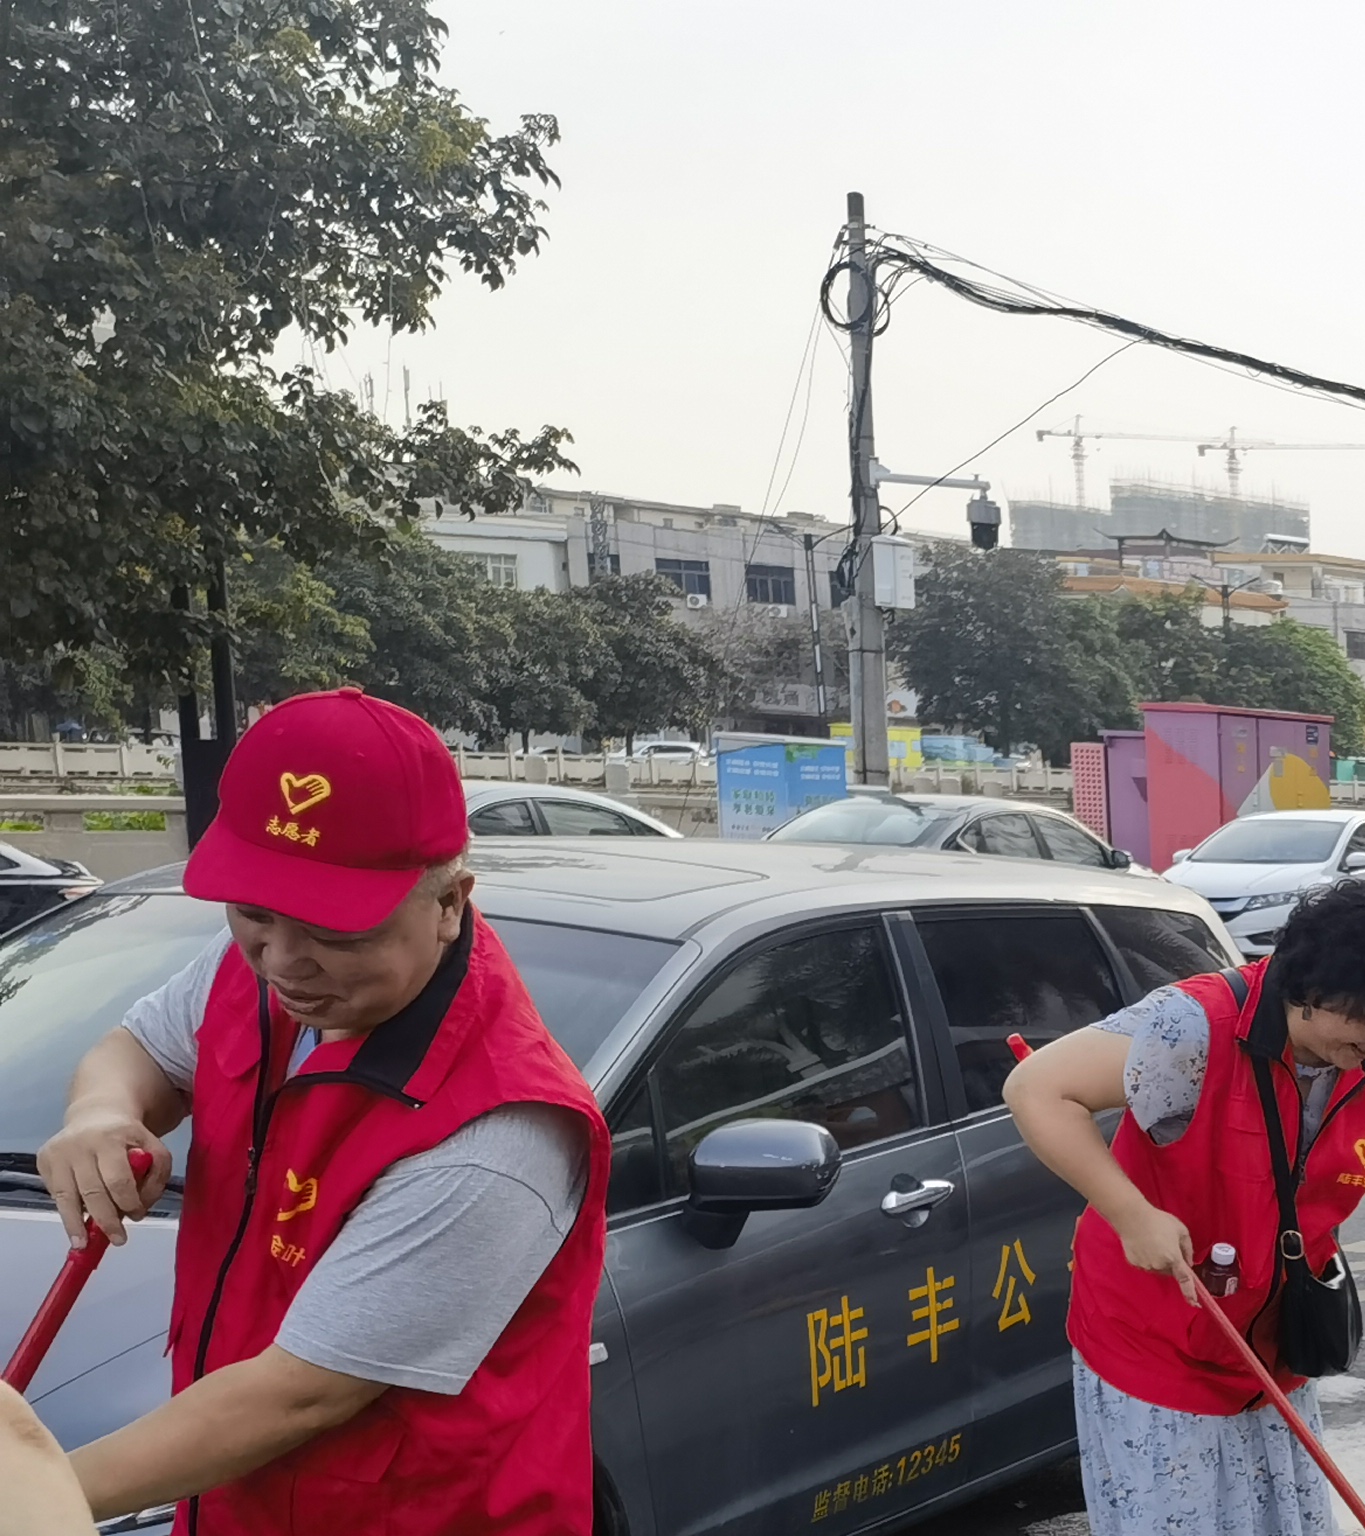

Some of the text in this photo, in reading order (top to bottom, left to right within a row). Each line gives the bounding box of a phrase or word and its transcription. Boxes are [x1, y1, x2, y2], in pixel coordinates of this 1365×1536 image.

[265, 814, 321, 847] 志愿者
[806, 1214, 1081, 1408] 陆丰公
